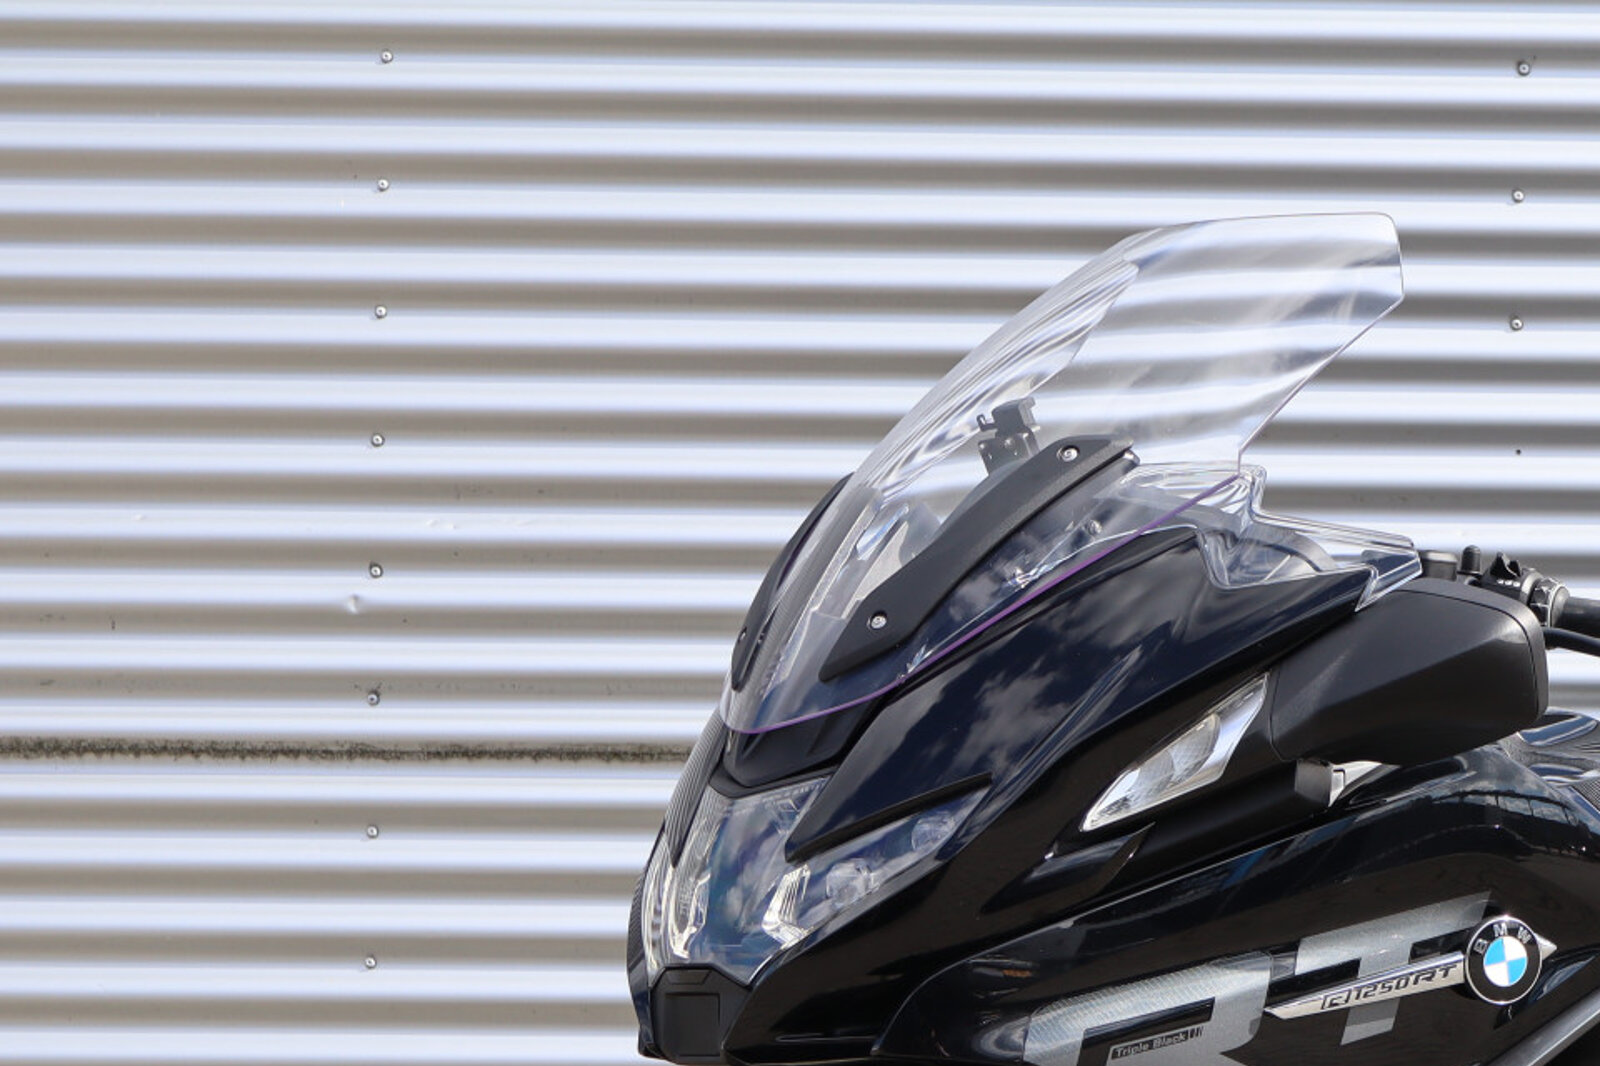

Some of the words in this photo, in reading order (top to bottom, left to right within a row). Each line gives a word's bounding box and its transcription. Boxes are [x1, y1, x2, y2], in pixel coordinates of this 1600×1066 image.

[1474, 921, 1533, 955] BMW
[1115, 1042, 1150, 1058] Triple
[1152, 1031, 1188, 1049] Black
